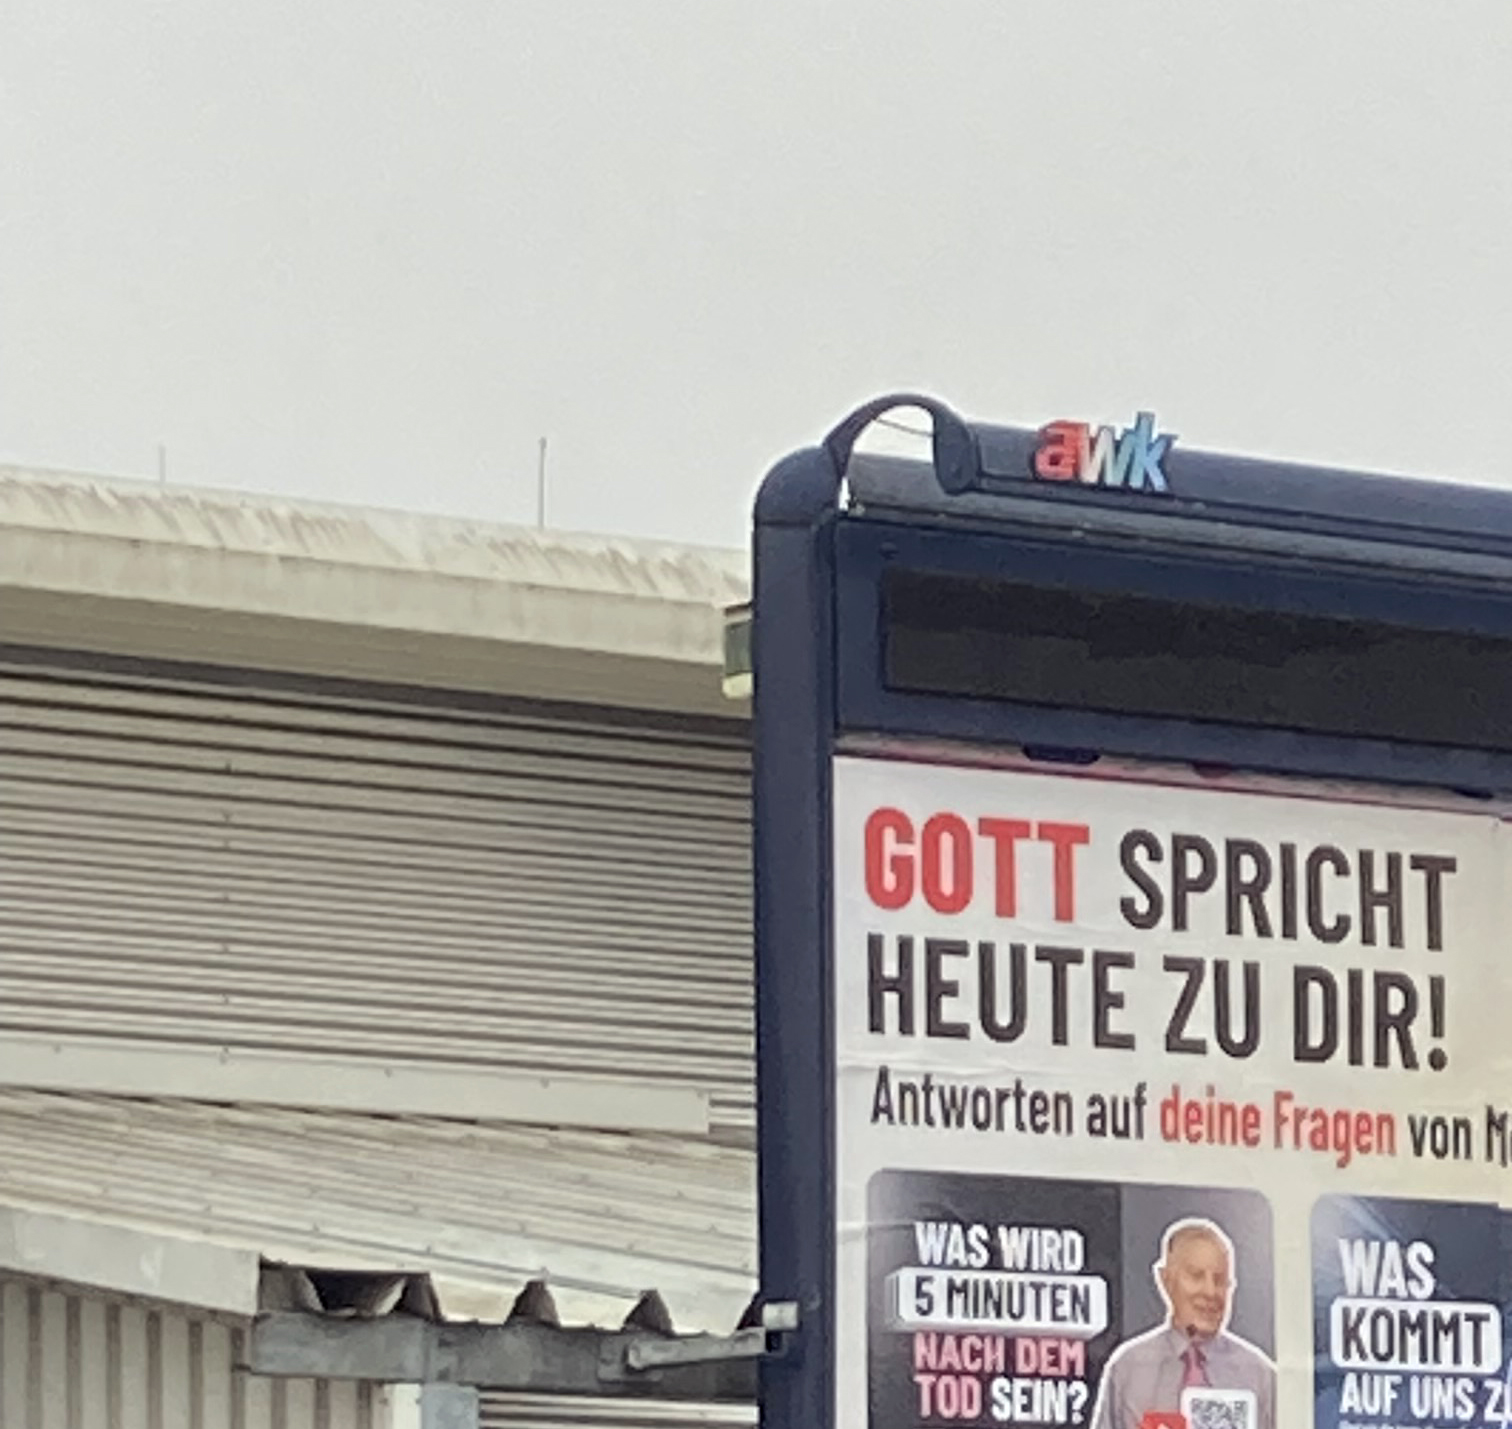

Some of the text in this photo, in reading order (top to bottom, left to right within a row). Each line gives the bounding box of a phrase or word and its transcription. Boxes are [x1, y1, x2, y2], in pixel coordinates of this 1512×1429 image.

[1030, 411, 1179, 493] awk
[864, 807, 1458, 952] GOTT SPRICHT
[866, 932, 1451, 1072] HEUTE ZU DIR!
[871, 1066, 1075, 1137] Antworten
[1086, 1082, 1149, 1141] auf
[1160, 1083, 1262, 1149] deine
[1273, 1090, 1397, 1169] Fragen
[1407, 1112, 1473, 1161] von
[913, 1221, 1086, 1273] WAS WIRD
[1338, 1238, 1437, 1301] WAS
[914, 1275, 1092, 1326] 5 MINUTEN
[913, 1331, 1086, 1379] NACH DEM
[1341, 1305, 1492, 1368] KOMMT
[913, 1374, 1089, 1425] TOD SEIN?
[1339, 1372, 1403, 1417] AUF
[1409, 1376, 1476, 1421] UNS
